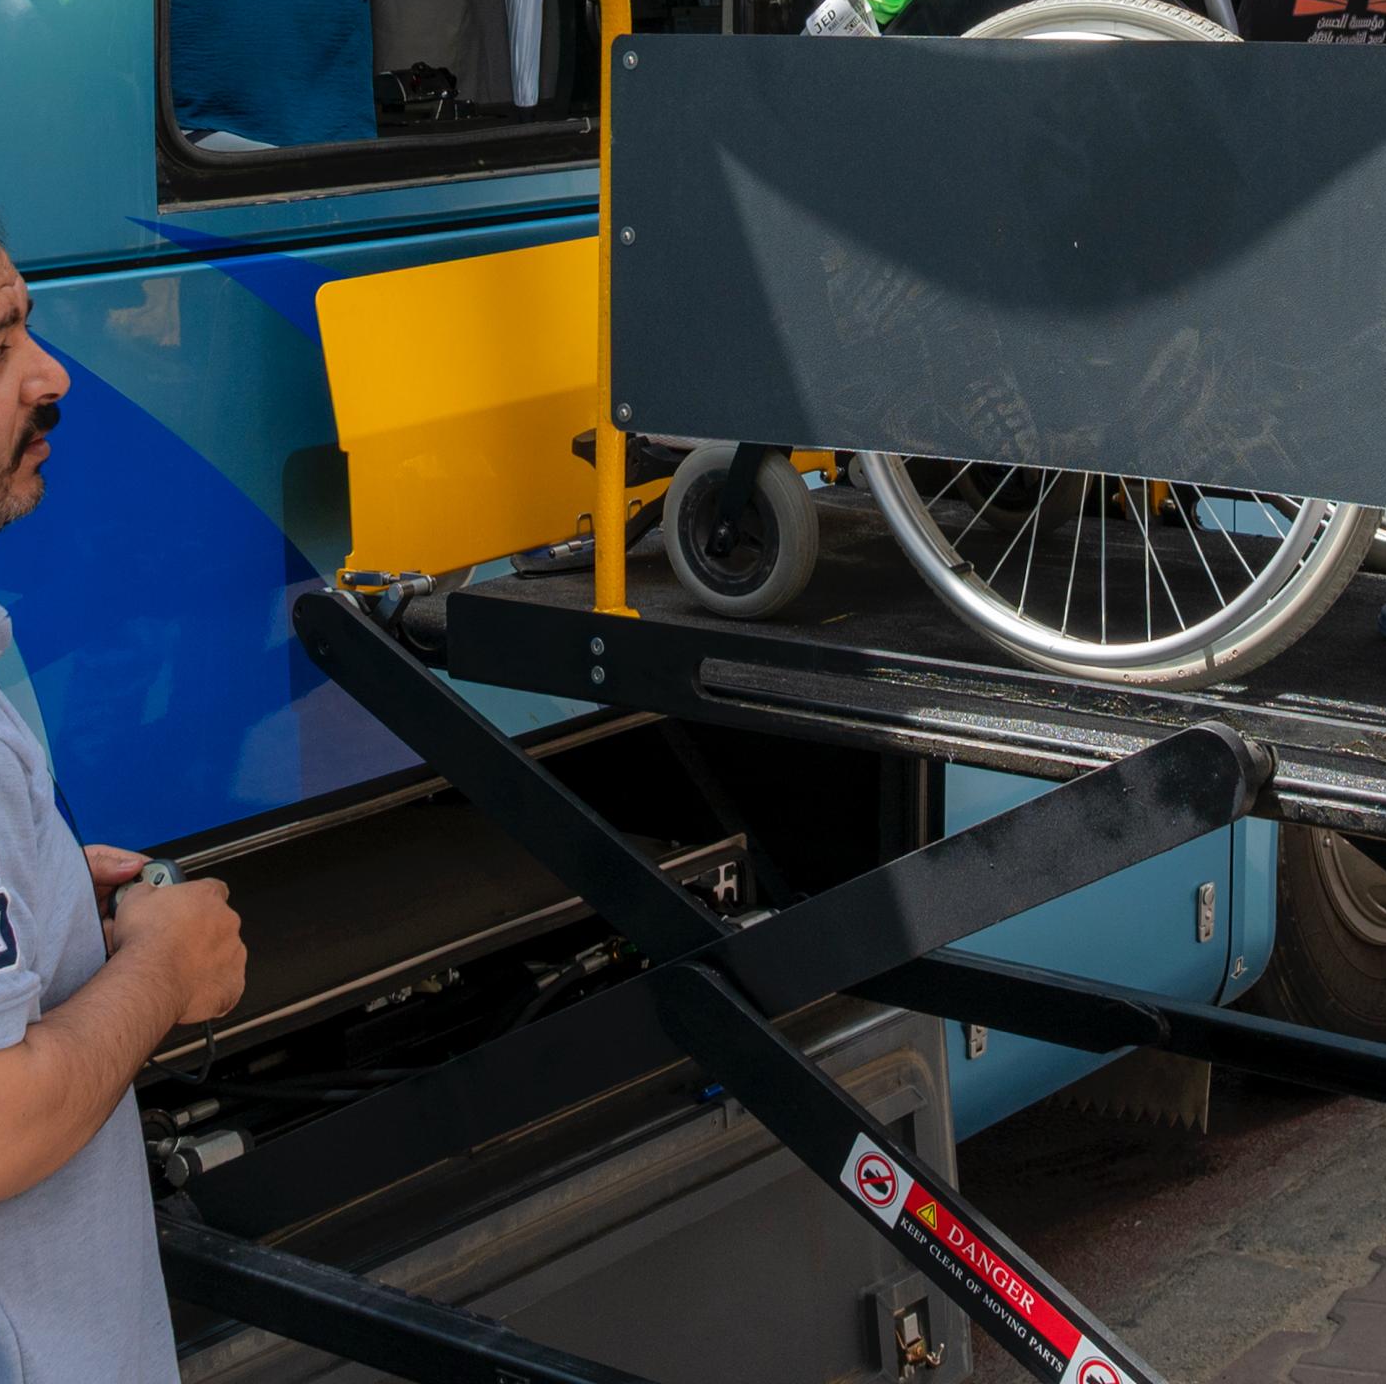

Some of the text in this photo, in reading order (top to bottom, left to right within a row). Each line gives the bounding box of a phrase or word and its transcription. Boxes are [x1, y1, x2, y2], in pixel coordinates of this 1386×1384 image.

[814, 9, 836, 34] JED
[900, 1216, 1065, 1373] KEEP CLEAR OF MOVING PARTS
[946, 1223, 1037, 1315] DANGER
